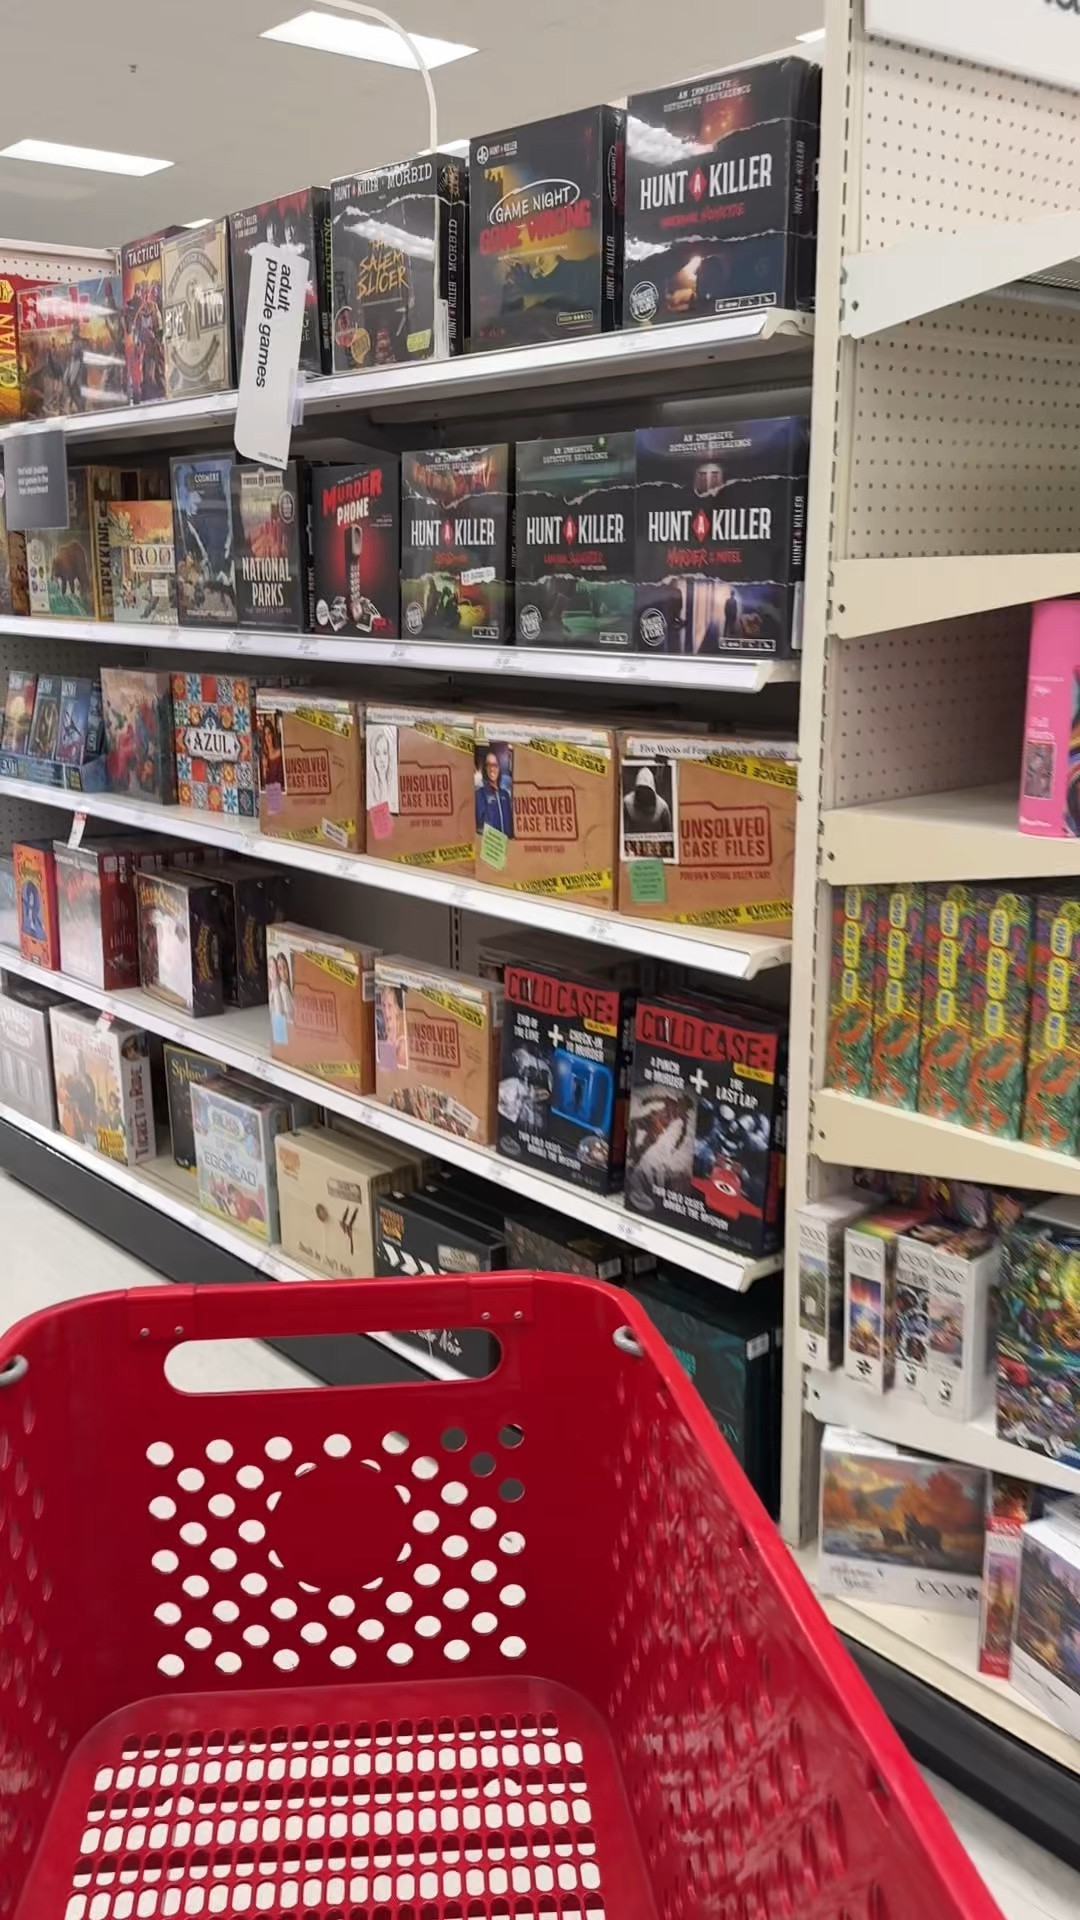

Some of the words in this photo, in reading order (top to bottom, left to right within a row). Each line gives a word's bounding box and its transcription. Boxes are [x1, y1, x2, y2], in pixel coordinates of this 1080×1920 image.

[334, 185, 350, 201] HUNT
[357, 177, 379, 197] KILLER
[387, 162, 433, 189] MORBID
[640, 170, 688, 211] HUNT
[693, 173, 701, 193] A
[709, 153, 772, 197] KILLER
[496, 203, 529, 223] GAME
[533, 186, 571, 210] NIGHT
[127, 242, 162, 266] TACTICU
[448, 218, 458, 272] MORBID
[606, 235, 615, 267] KILLER
[359, 249, 405, 276] SALEM
[262, 257, 278, 320] puzzle
[281, 264, 292, 313] adult
[356, 265, 409, 300] SLICER
[448, 281, 457, 308] KILLER
[607, 276, 615, 300] HUNT
[255, 322, 272, 389] games
[322, 468, 382, 517] MURDER
[337, 496, 369, 527] PHONE
[648, 510, 692, 542] HUNT
[697, 515, 705, 534] A
[712, 507, 772, 540] KILLER
[793, 495, 804, 528] KILLER
[411, 519, 441, 546] HUNT
[454, 518, 496, 546] KILLER
[526, 516, 563, 545] HUNT
[578, 514, 624, 544] KILLER
[130, 547, 174, 566] ROO
[792, 538, 803, 565] HUNT
[242, 557, 292, 582] NATIONAL
[252, 582, 284, 607] PARKS
[193, 732, 231, 753] AZUL
[529, 738, 559, 758] EVIDEN
[640, 744, 655, 753] Five
[656, 744, 680, 754] Weeks
[285, 756, 327, 775] UNSOLVED
[706, 755, 748, 776] EVIDEN
[753, 766, 797, 788] IDENCE
[287, 774, 305, 788] CASE
[307, 773, 328, 789] FILES
[400, 773, 449, 794] UNSOLVED
[401, 792, 422, 808] CASE
[425, 792, 449, 808] FILES
[514, 795, 573, 816] UNSOLVED
[516, 816, 541, 832] CASE
[545, 816, 574, 832] FILES
[681, 816, 765, 839] UNSOLVED
[683, 840, 718, 858] CASE
[725, 839, 765, 857] FILES
[508, 972, 552, 1008] COLD
[557, 985, 614, 1024] CASE:
[524, 1026, 540, 1043] LINE
[641, 1010, 695, 1050] COLD
[701, 1025, 769, 1070] CASE:
[432, 1043, 456, 1059] FILES
[716, 1085, 739, 1105] LAST
[740, 1091, 758, 1110] LAP
[204, 1151, 258, 1188] EGGHEAD
